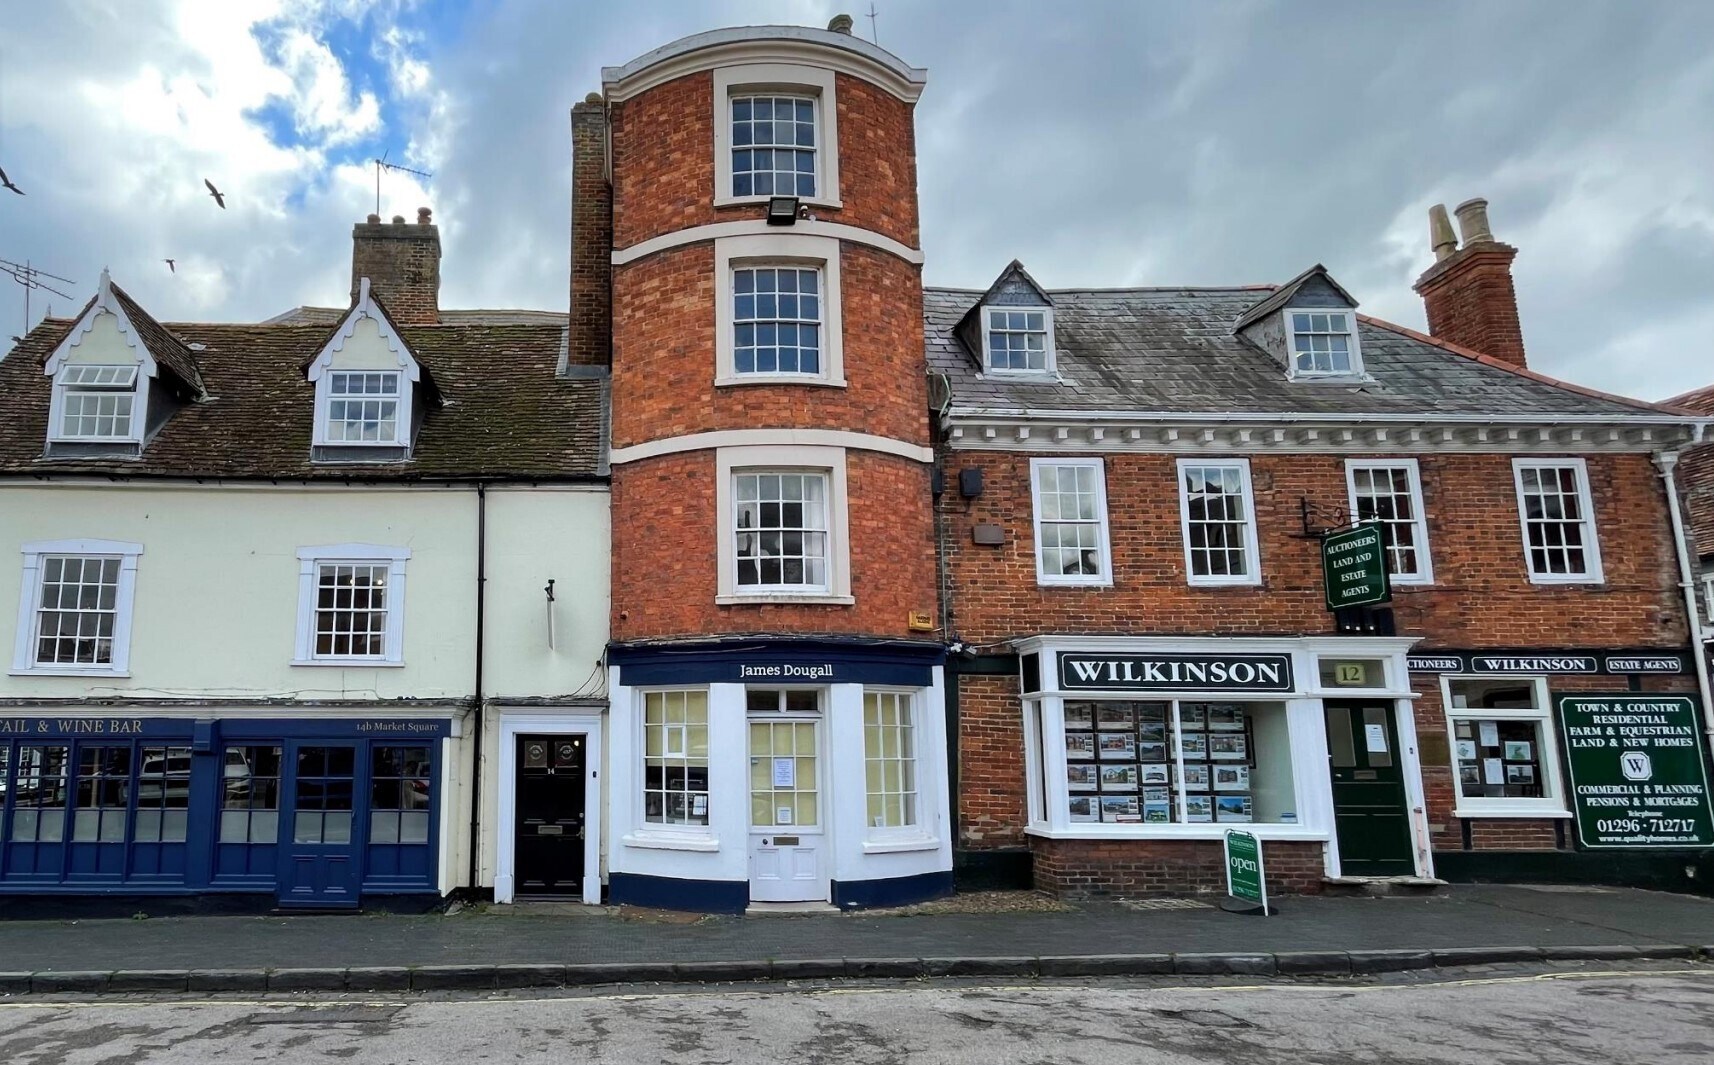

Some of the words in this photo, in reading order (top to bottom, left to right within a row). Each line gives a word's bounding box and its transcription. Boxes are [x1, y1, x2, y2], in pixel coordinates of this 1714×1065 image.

[1327, 535, 1376, 555] AUCTIONEERS
[1333, 556, 1353, 568] LAND
[1355, 552, 1372, 563] AND
[1341, 570, 1367, 582] ESTATE
[1342, 585, 1370, 597] AGENTS
[1483, 659, 1586, 670] WILKINSON
[1609, 660, 1641, 670] ESTATE
[1643, 660, 1679, 670] AGENTS
[740, 665, 780, 678] James
[783, 664, 833, 679] Dougall
[1070, 660, 1280, 684] WILKINSON
[1341, 666, 1360, 682] 12
[1575, 703, 1609, 712] TOWN
[1613, 703, 1623, 712] &
[1627, 703, 1681, 712] COUNTRY
[1593, 715, 1668, 724] RESIDENTIAL
[37, 720, 49, 733] &
[58, 720, 104, 733] WINE
[110, 720, 143, 733] BAR
[374, 722, 405, 731] Market
[407, 722, 439, 733] Square
[1569, 726, 1602, 736] FARM
[1605, 726, 1616, 735] &
[1620, 726, 1692, 738] EQUESTRIAN
[1572, 738, 1605, 747] LAND
[1609, 738, 1619, 747] &
[1623, 738, 1650, 747] NEW
[1654, 738, 1694, 747] HOMES
[1626, 758, 1645, 774] W
[1577, 785, 1641, 794] COMMERCIAL
[1644, 785, 1652, 794] &
[1654, 785, 1703, 794] PLANNING
[1586, 797, 1630, 807] PENSIONS
[1632, 797, 1641, 806] &
[1643, 797, 1699, 807] MORTGAGES
[1597, 819, 1641, 832] 01296
[1649, 819, 1696, 832] 712717
[1231, 856, 1257, 874] open
